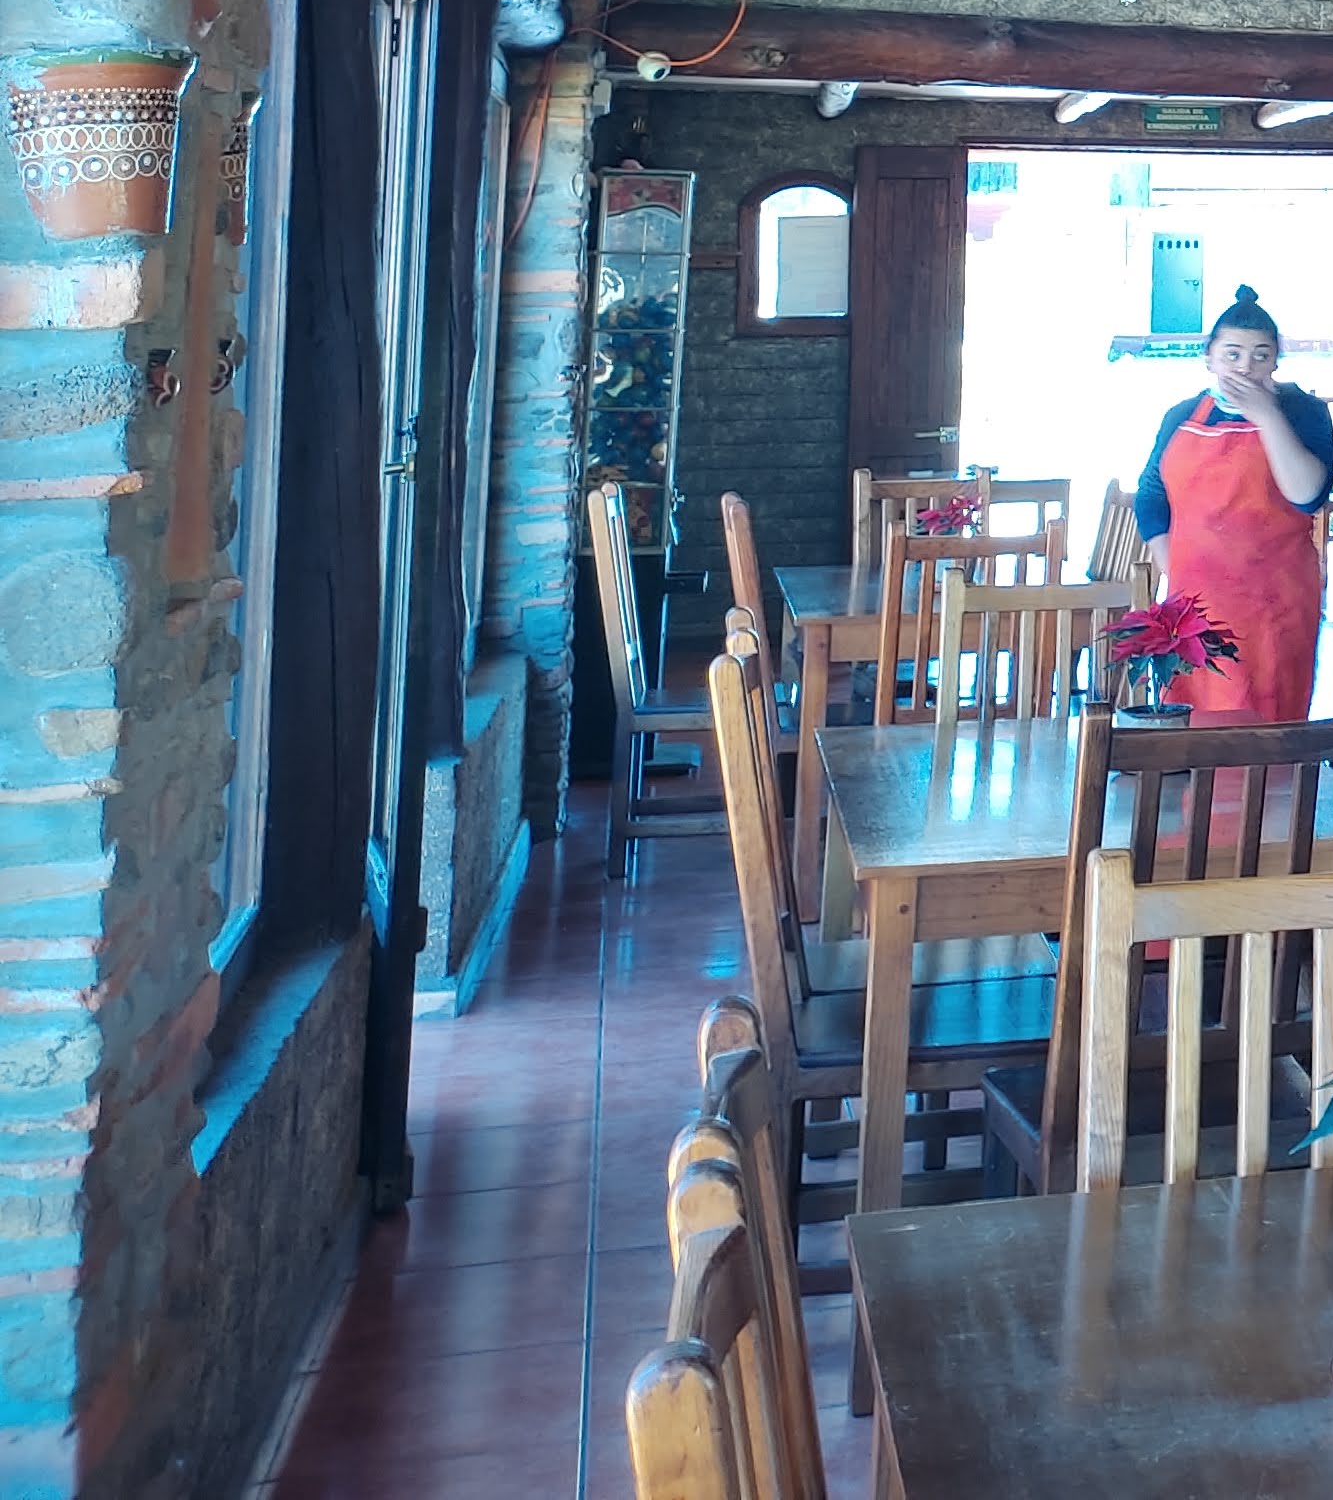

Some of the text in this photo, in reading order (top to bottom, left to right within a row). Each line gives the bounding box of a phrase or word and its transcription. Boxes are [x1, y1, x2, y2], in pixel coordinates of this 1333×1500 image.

[1161, 107, 1191, 115] SALIDA
[1146, 122, 1218, 131] EMERGENCY EXIT
